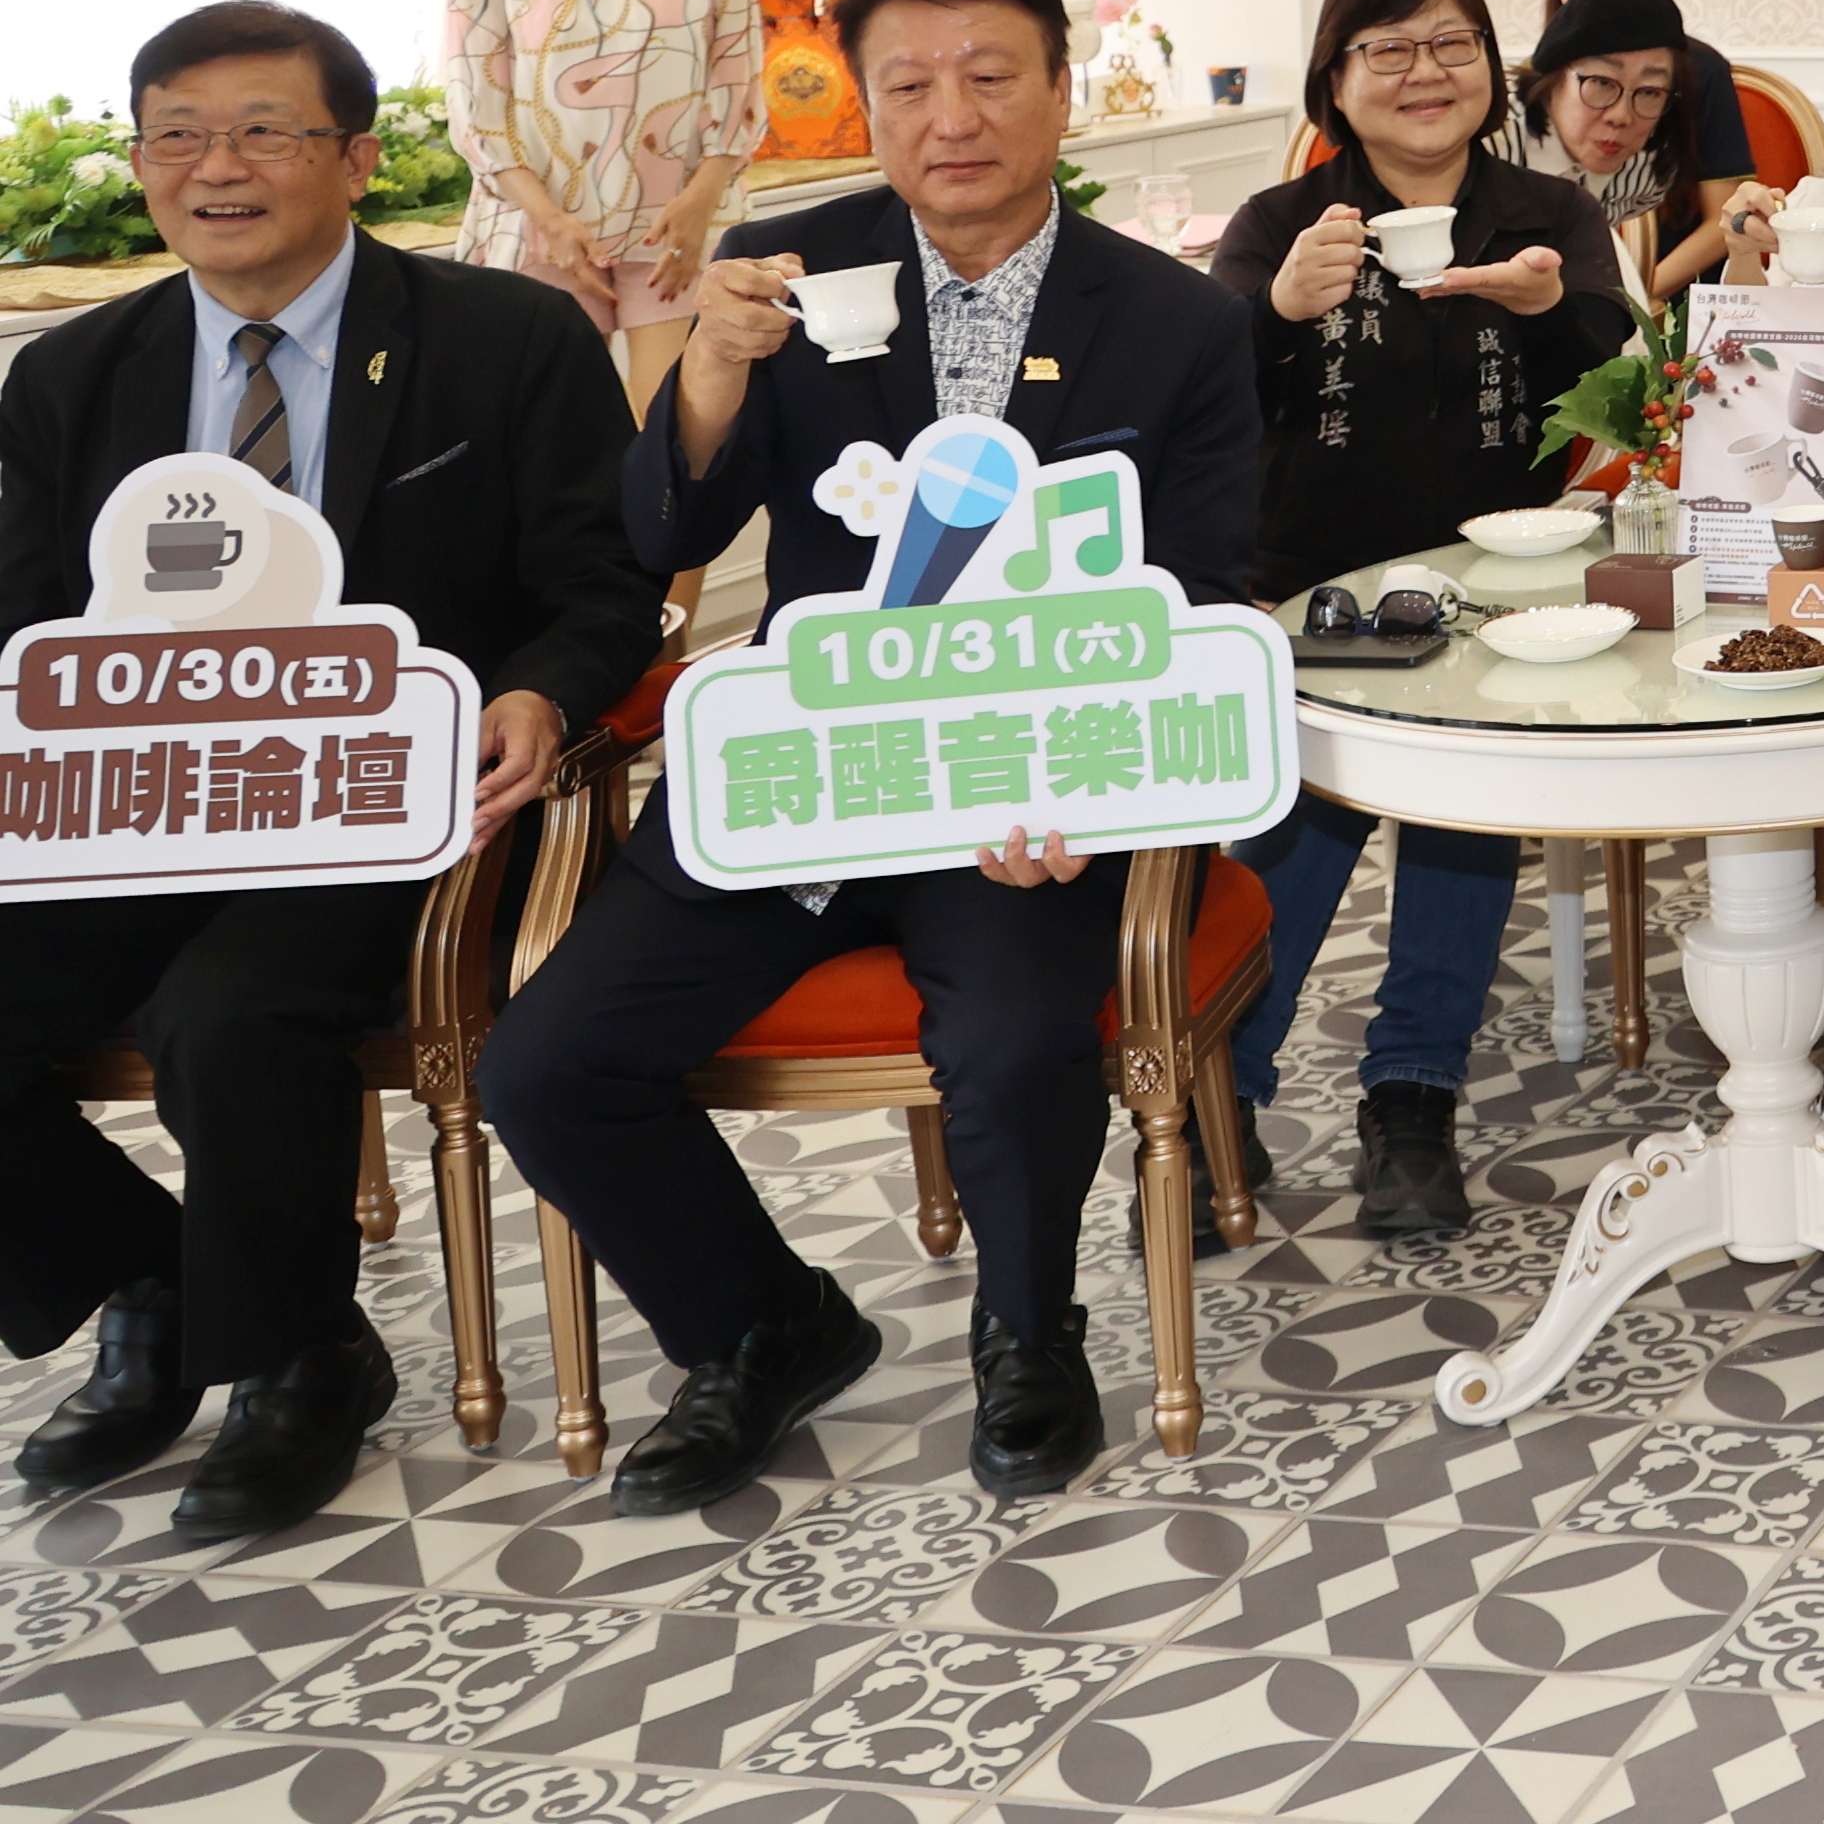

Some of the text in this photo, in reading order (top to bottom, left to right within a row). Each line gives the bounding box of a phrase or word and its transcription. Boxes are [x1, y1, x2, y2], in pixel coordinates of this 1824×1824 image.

[1354, 269, 1389, 345] 議員
[48, 646, 375, 708] 10/30(五)
[818, 613, 1148, 686] 10/31(六)
[0, 731, 413, 843] 咖啡論壇
[718, 693, 1252, 835] 爵醒音樂咖
